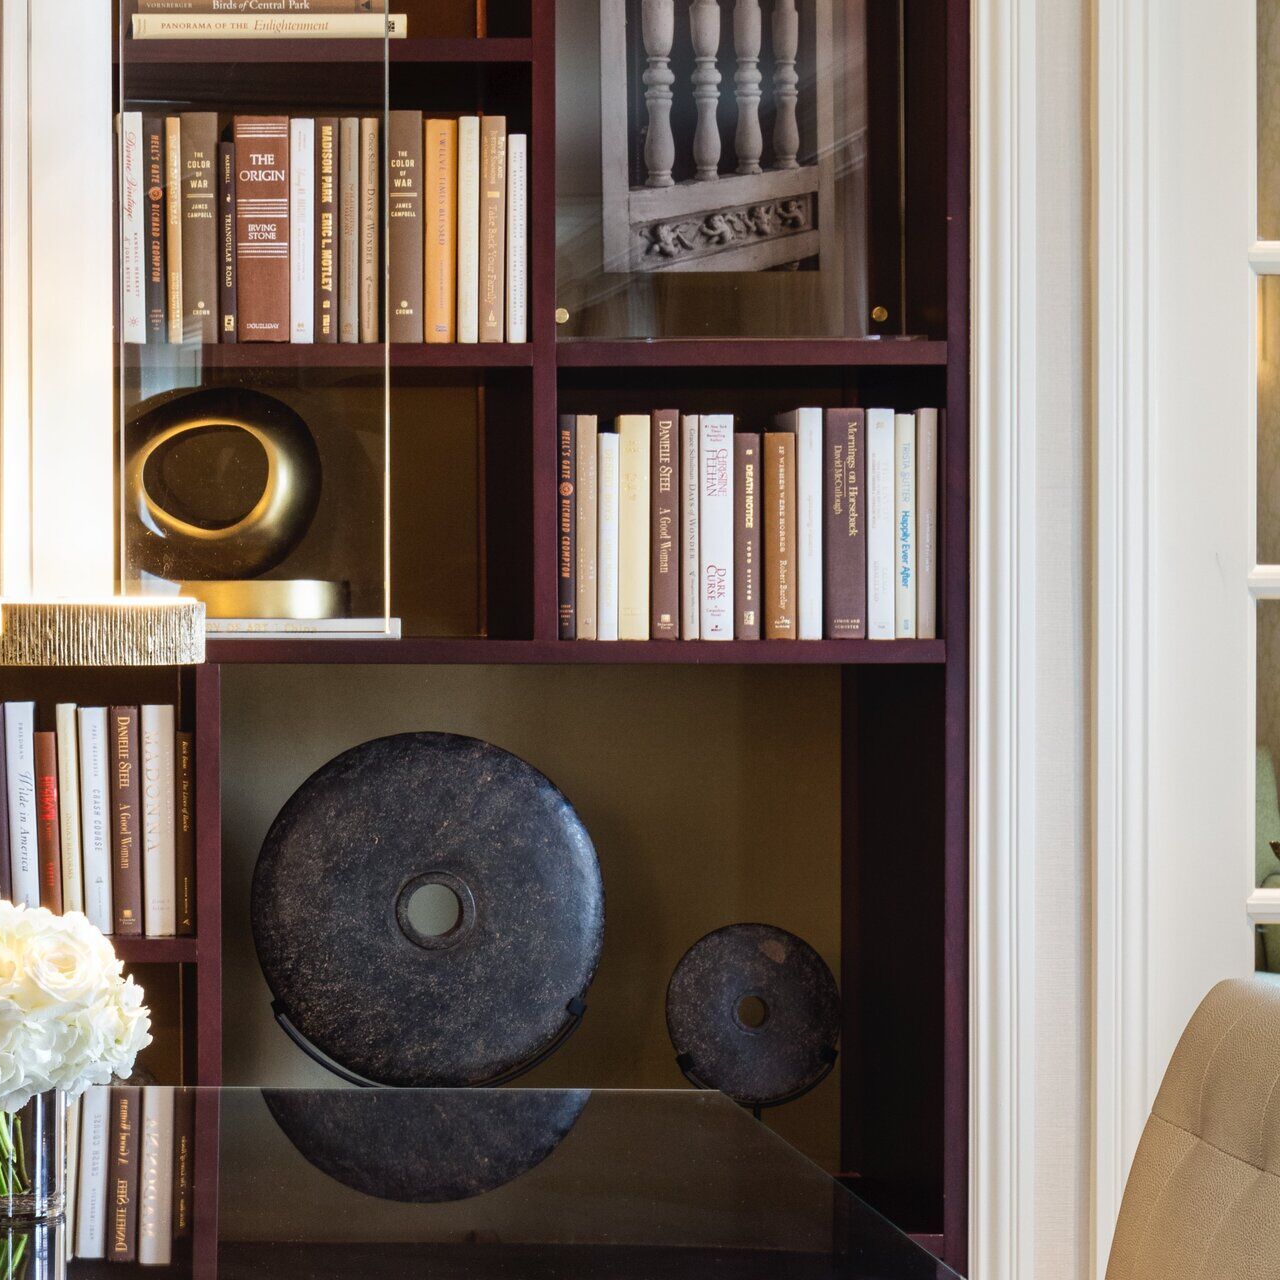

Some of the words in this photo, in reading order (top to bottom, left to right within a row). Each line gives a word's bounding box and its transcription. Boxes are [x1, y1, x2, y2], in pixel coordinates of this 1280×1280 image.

[212, 0, 237, 10] Birds
[238, 0, 248, 11] of
[249, 0, 286, 10] Central
[288, 0, 310, 10] Park
[160, 22, 212, 30] PANORAMA
[215, 22, 228, 30] OF
[230, 22, 248, 30] THE
[253, 19, 329, 31] Enlightenment
[125, 130, 136, 172] Divine
[150, 134, 160, 161] HELL'S
[250, 153, 275, 166] THE
[321, 125, 333, 174] MADISON
[397, 150, 408, 158] THE
[150, 163, 160, 183] GATE
[187, 160, 211, 170] COLOR
[239, 169, 286, 183] ORIGIN
[390, 159, 415, 169] COLOR
[190, 179, 209, 189] WAR
[321, 175, 333, 203] PARK
[394, 178, 413, 188] WAR
[125, 174, 138, 223] Vintage
[395, 202, 412, 210] JAMES
[150, 203, 160, 237] RICHARD
[248, 223, 277, 232] IRVING
[321, 211, 333, 238] ERIC
[390, 210, 416, 218] CAMPBELL
[486, 204, 498, 227] Take
[224, 213, 233, 264] TRIANGULAR
[248, 231, 277, 240] STONE
[321, 238, 332, 248] L.
[486, 227, 498, 249] Back
[150, 240, 160, 283] CROMPTON
[321, 249, 333, 292] MOTLEY
[486, 250, 498, 273] Your
[224, 265, 233, 288] ROAD
[484, 273, 498, 306] Family
[561, 430, 571, 457] HELL'S
[659, 420, 673, 463] DANIELLE
[688, 428, 696, 448] Grace
[846, 421, 858, 470] Mornings
[561, 459, 571, 479] GATE
[688, 448, 696, 480] Schulman
[833, 444, 843, 468] David
[902, 442, 911, 469] TRISTA
[659, 465, 673, 494] STEEL
[705, 448, 718, 497] FEEHAN
[745, 463, 754, 495] DEATH
[847, 471, 857, 485] on
[687, 483, 697, 508] DAYS
[832, 468, 843, 516] McCullough
[901, 471, 911, 503] SUTTER
[561, 498, 571, 533] RICHARD
[659, 507, 672, 515] A
[745, 495, 754, 529] NOTICE
[847, 486, 858, 537] Horseback
[659, 517, 672, 540] Good
[687, 518, 697, 561] WONDER
[900, 510, 912, 543] Happily
[561, 535, 571, 579] CROMPTON
[659, 541, 672, 574] Woman
[901, 543, 911, 564] Ever
[705, 564, 718, 601] CURSE
[716, 567, 727, 599] DARK
[778, 560, 788, 584] Robert
[900, 565, 911, 588] After
[777, 584, 788, 610] Barclay
[117, 716, 132, 760] DANIELLE
[118, 761, 132, 789] STEEL
[17, 771, 33, 808] Wilde
[91, 788, 104, 816] CRASH
[144, 730, 161, 853] MADONNA
[20, 811, 28, 823] in
[119, 803, 130, 811] A
[93, 820, 104, 852] COURSE
[119, 811, 131, 835] Good
[19, 827, 30, 874] America
[120, 836, 133, 870] Woman
